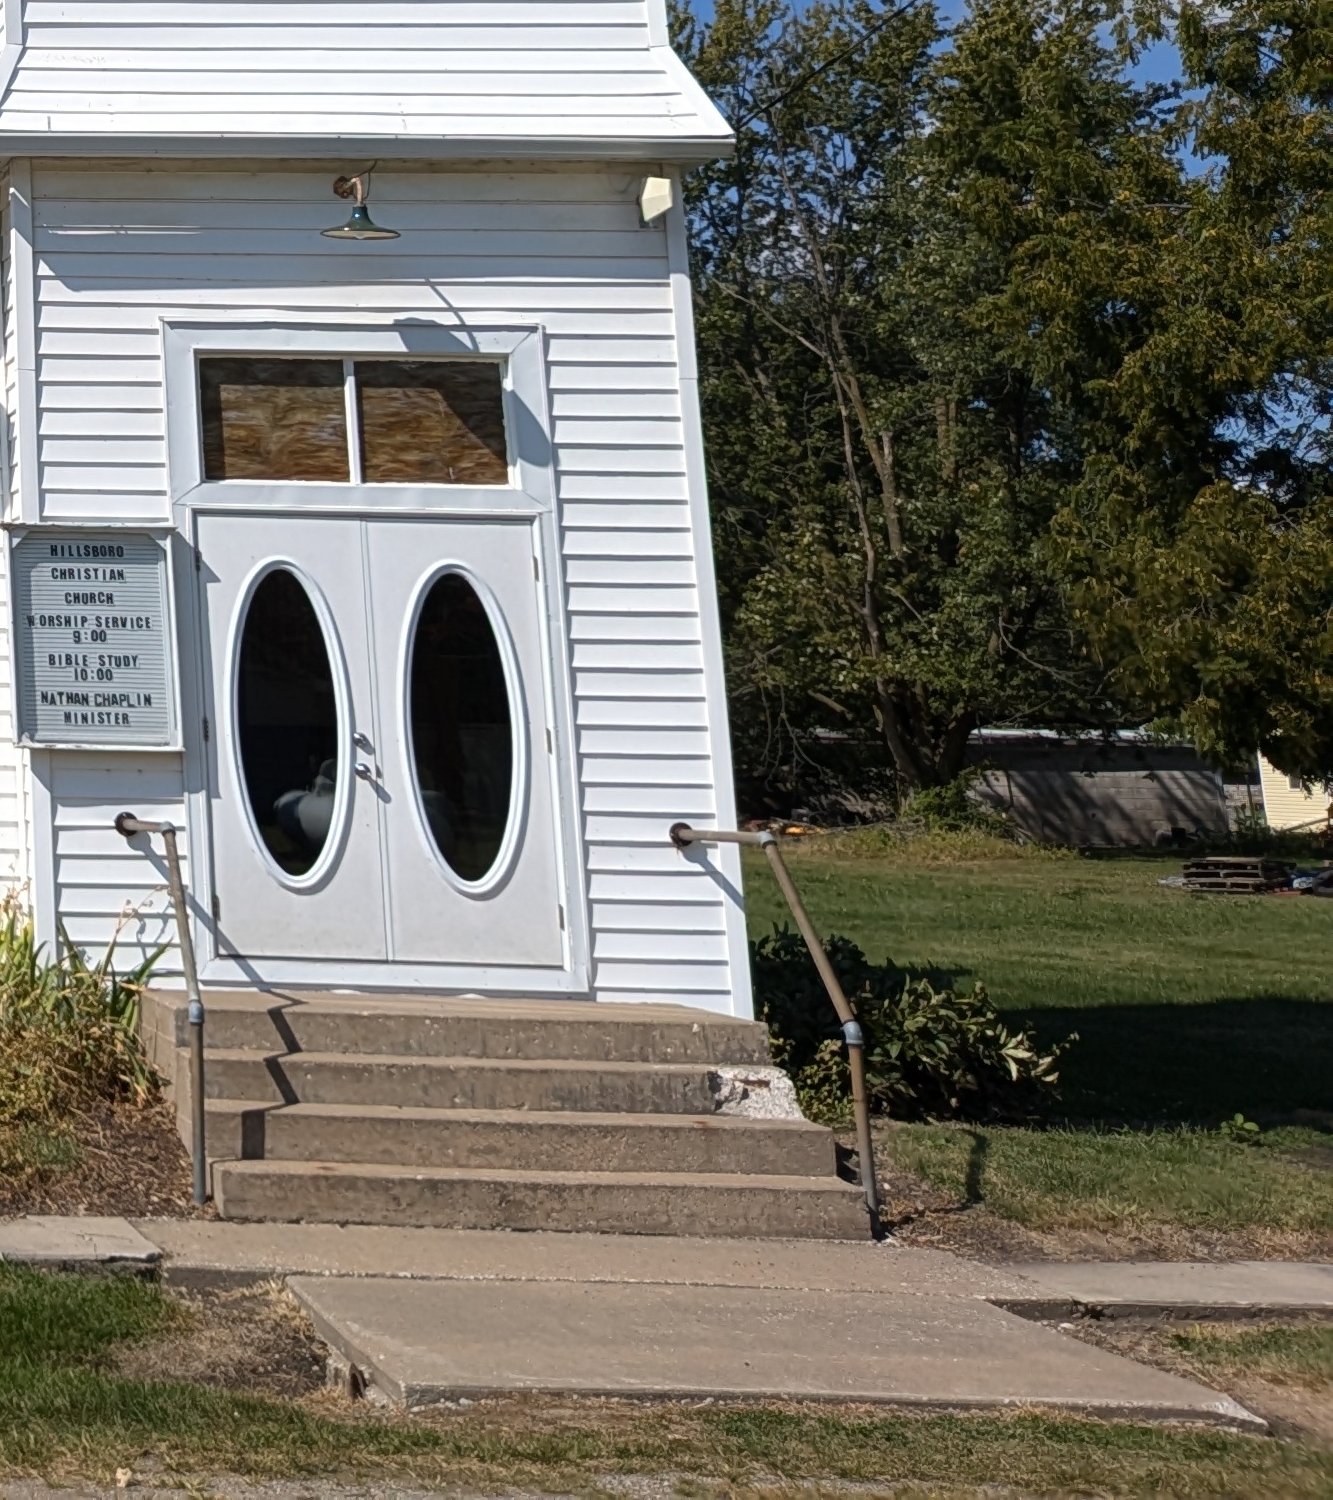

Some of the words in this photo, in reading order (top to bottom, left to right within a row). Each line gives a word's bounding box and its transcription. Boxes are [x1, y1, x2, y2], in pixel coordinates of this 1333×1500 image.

[50, 544, 124, 557] HILLSBORO
[51, 567, 125, 581] CHRISTIAN
[64, 592, 114, 604] CHURCH
[26, 615, 88, 627] WORSHIP
[95, 616, 151, 629] SERVICE
[73, 630, 107, 643] 9:00
[48, 654, 88, 666] BIBLE
[98, 654, 138, 667] STUDY
[74, 668, 113, 681] 10:00
[40, 691, 88, 706] NATHAN
[94, 692, 151, 707] CHAPLIN
[64, 712, 129, 724] MINISTER
